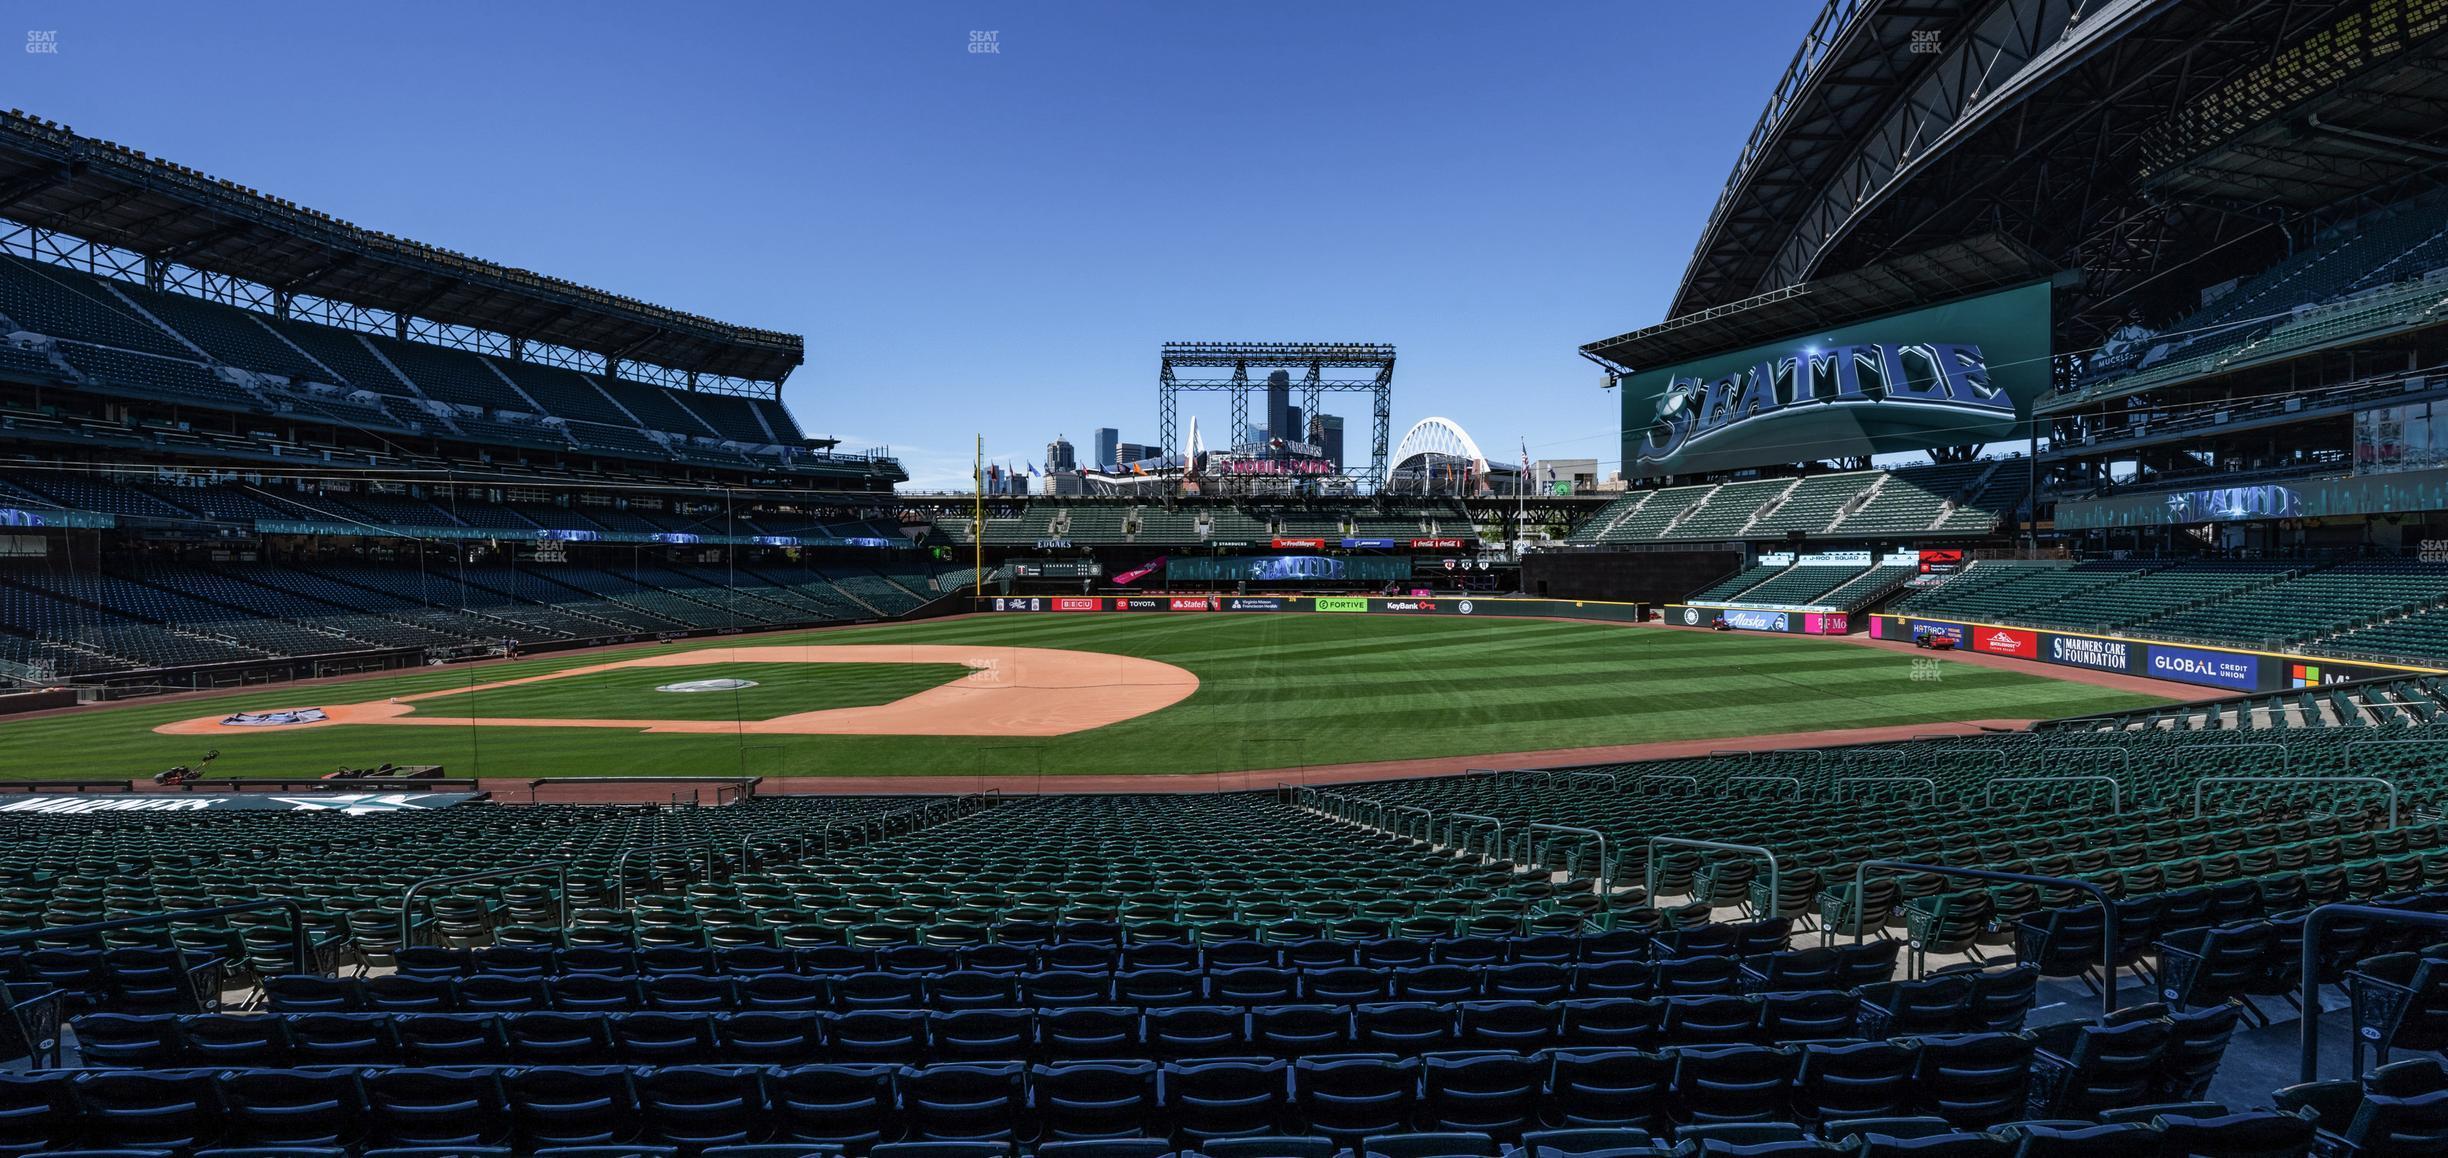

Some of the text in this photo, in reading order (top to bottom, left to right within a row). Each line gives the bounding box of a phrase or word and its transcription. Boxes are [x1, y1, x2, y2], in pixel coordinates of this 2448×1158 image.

[1638, 343, 2016, 462] SEATTLE
[1728, 613, 1766, 627] Alaska
[2065, 638, 2126, 656] MARINERS CARE
[2065, 649, 2126, 669] FOUNDATION
[2155, 655, 2248, 676] GLOBAL CREDIT
[2220, 671, 2245, 679] UNION
